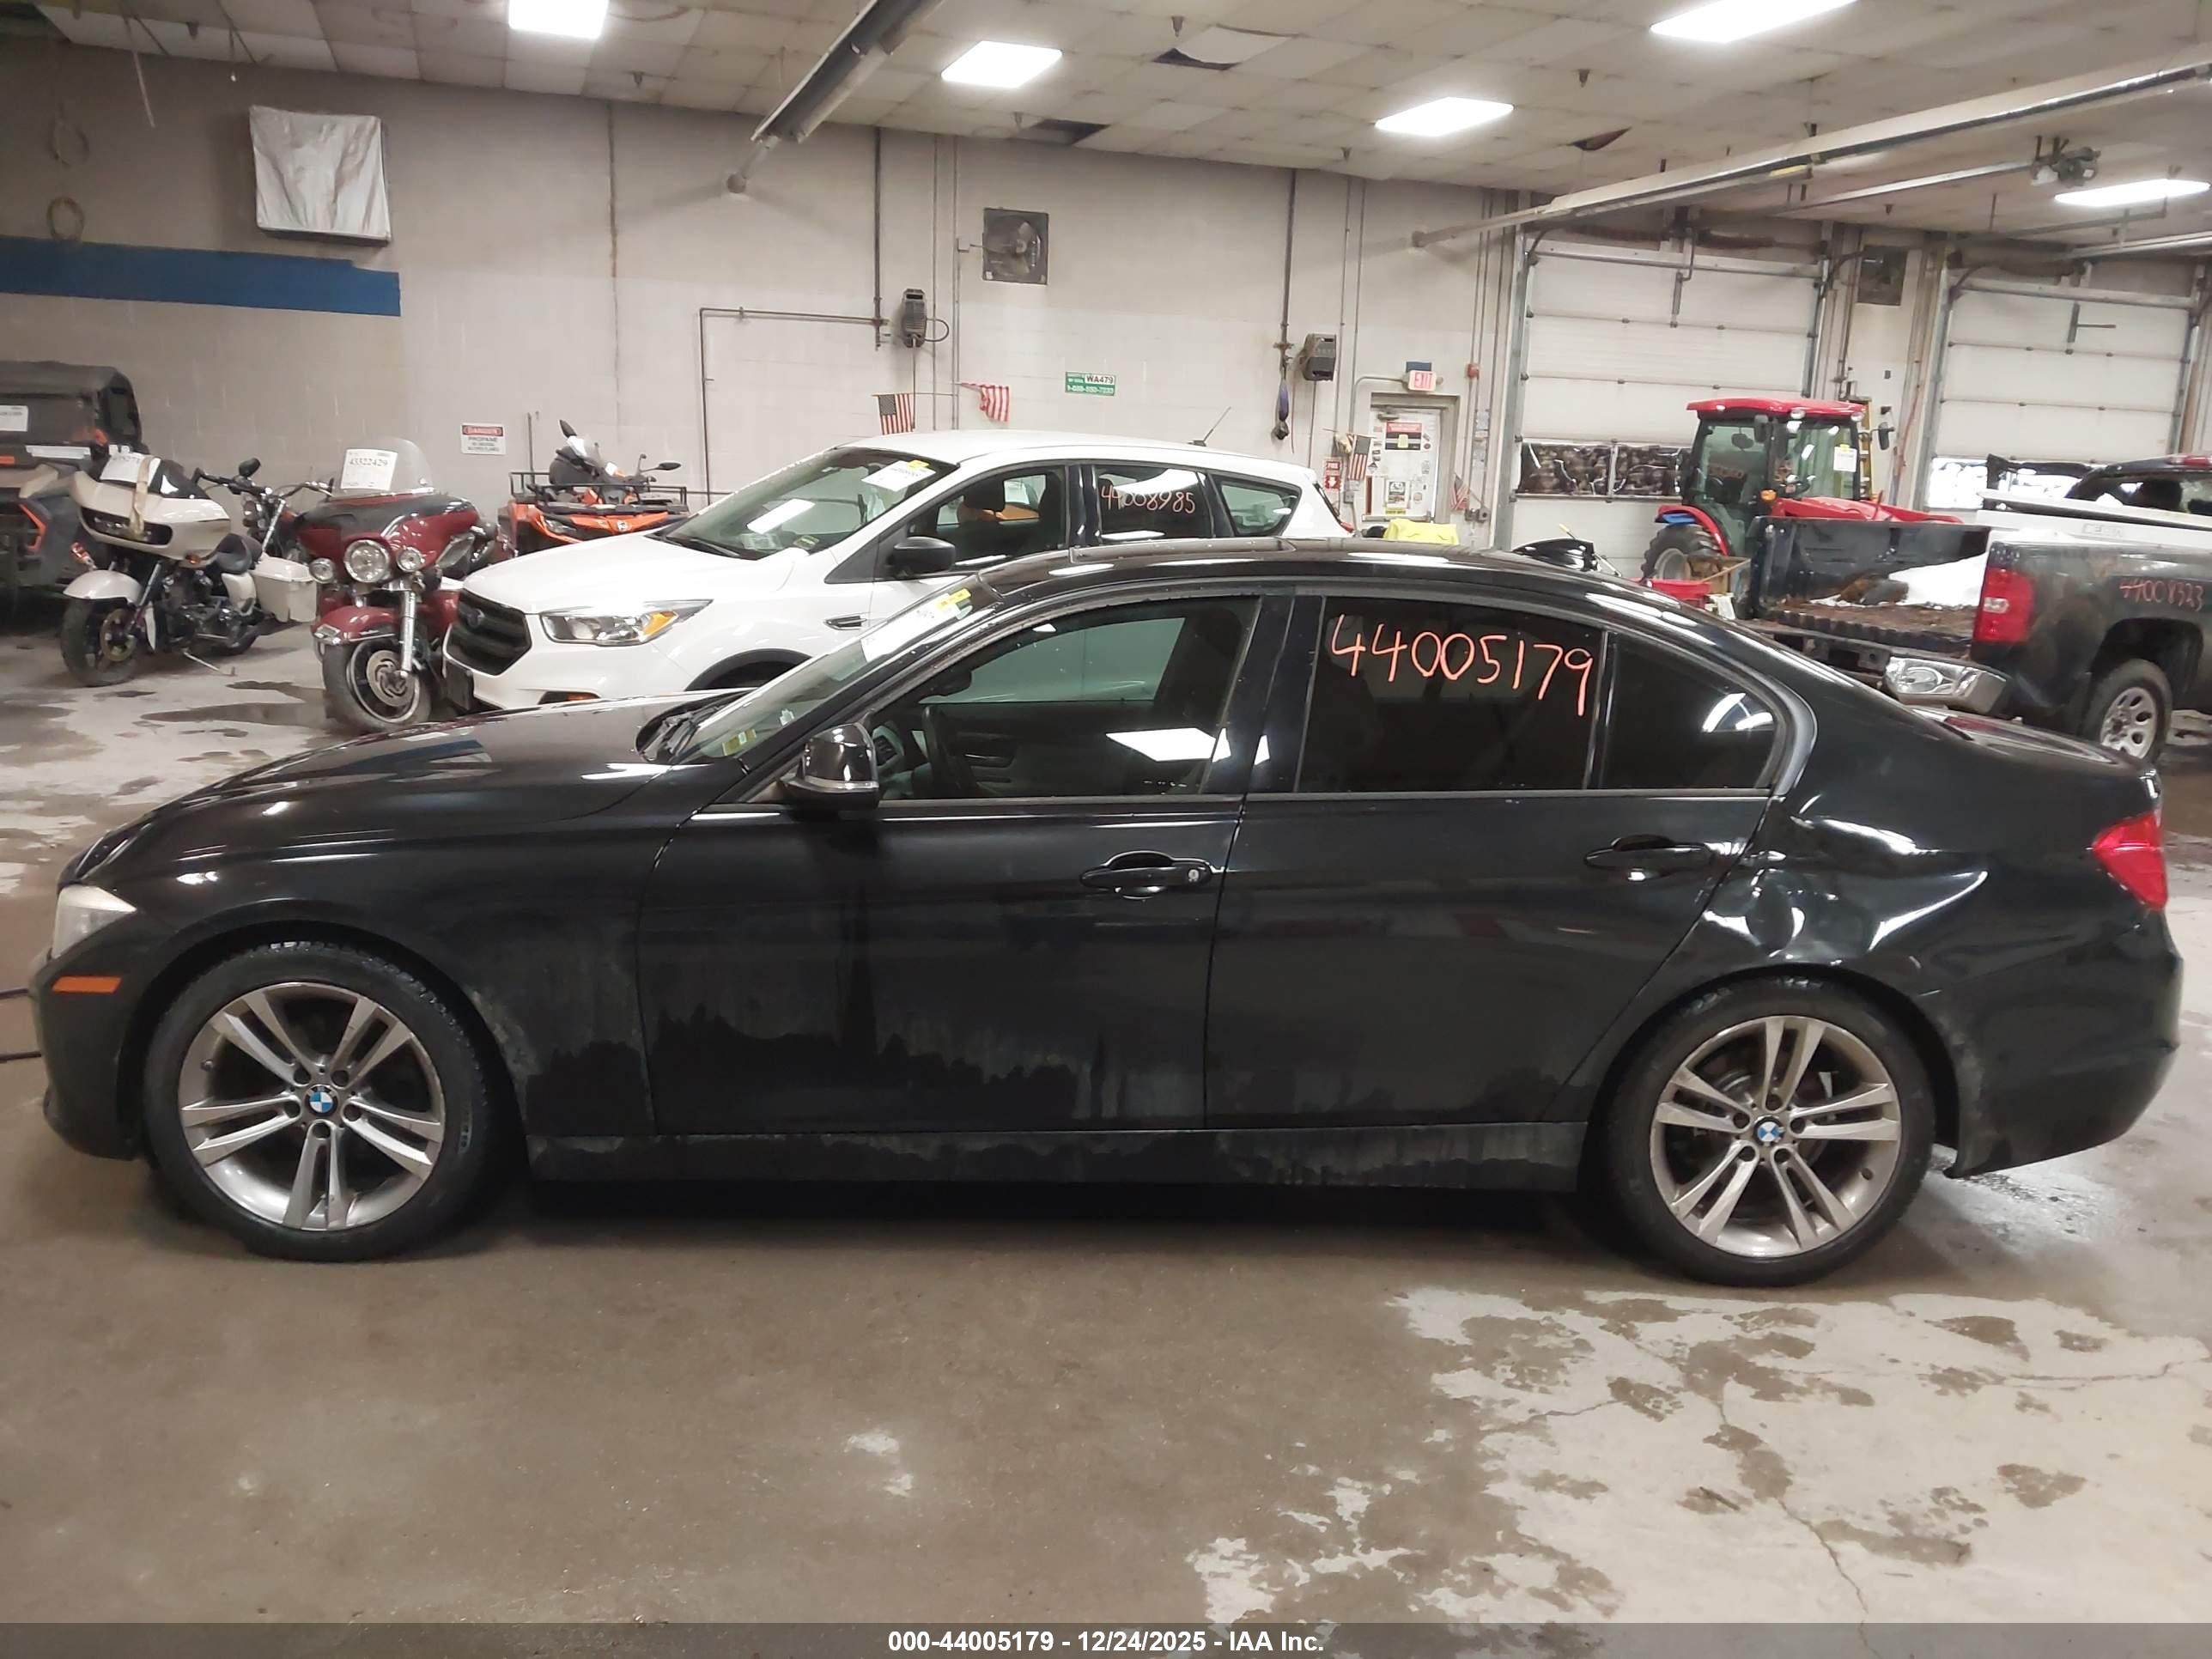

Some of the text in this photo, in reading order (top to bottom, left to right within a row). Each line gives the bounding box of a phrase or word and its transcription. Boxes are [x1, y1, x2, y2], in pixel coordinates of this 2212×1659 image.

[1086, 375, 1114, 384] WA479
[1415, 372, 1432, 388] EXIT
[1101, 485, 1195, 514] 44008985
[1331, 613, 1593, 716] 44005179
